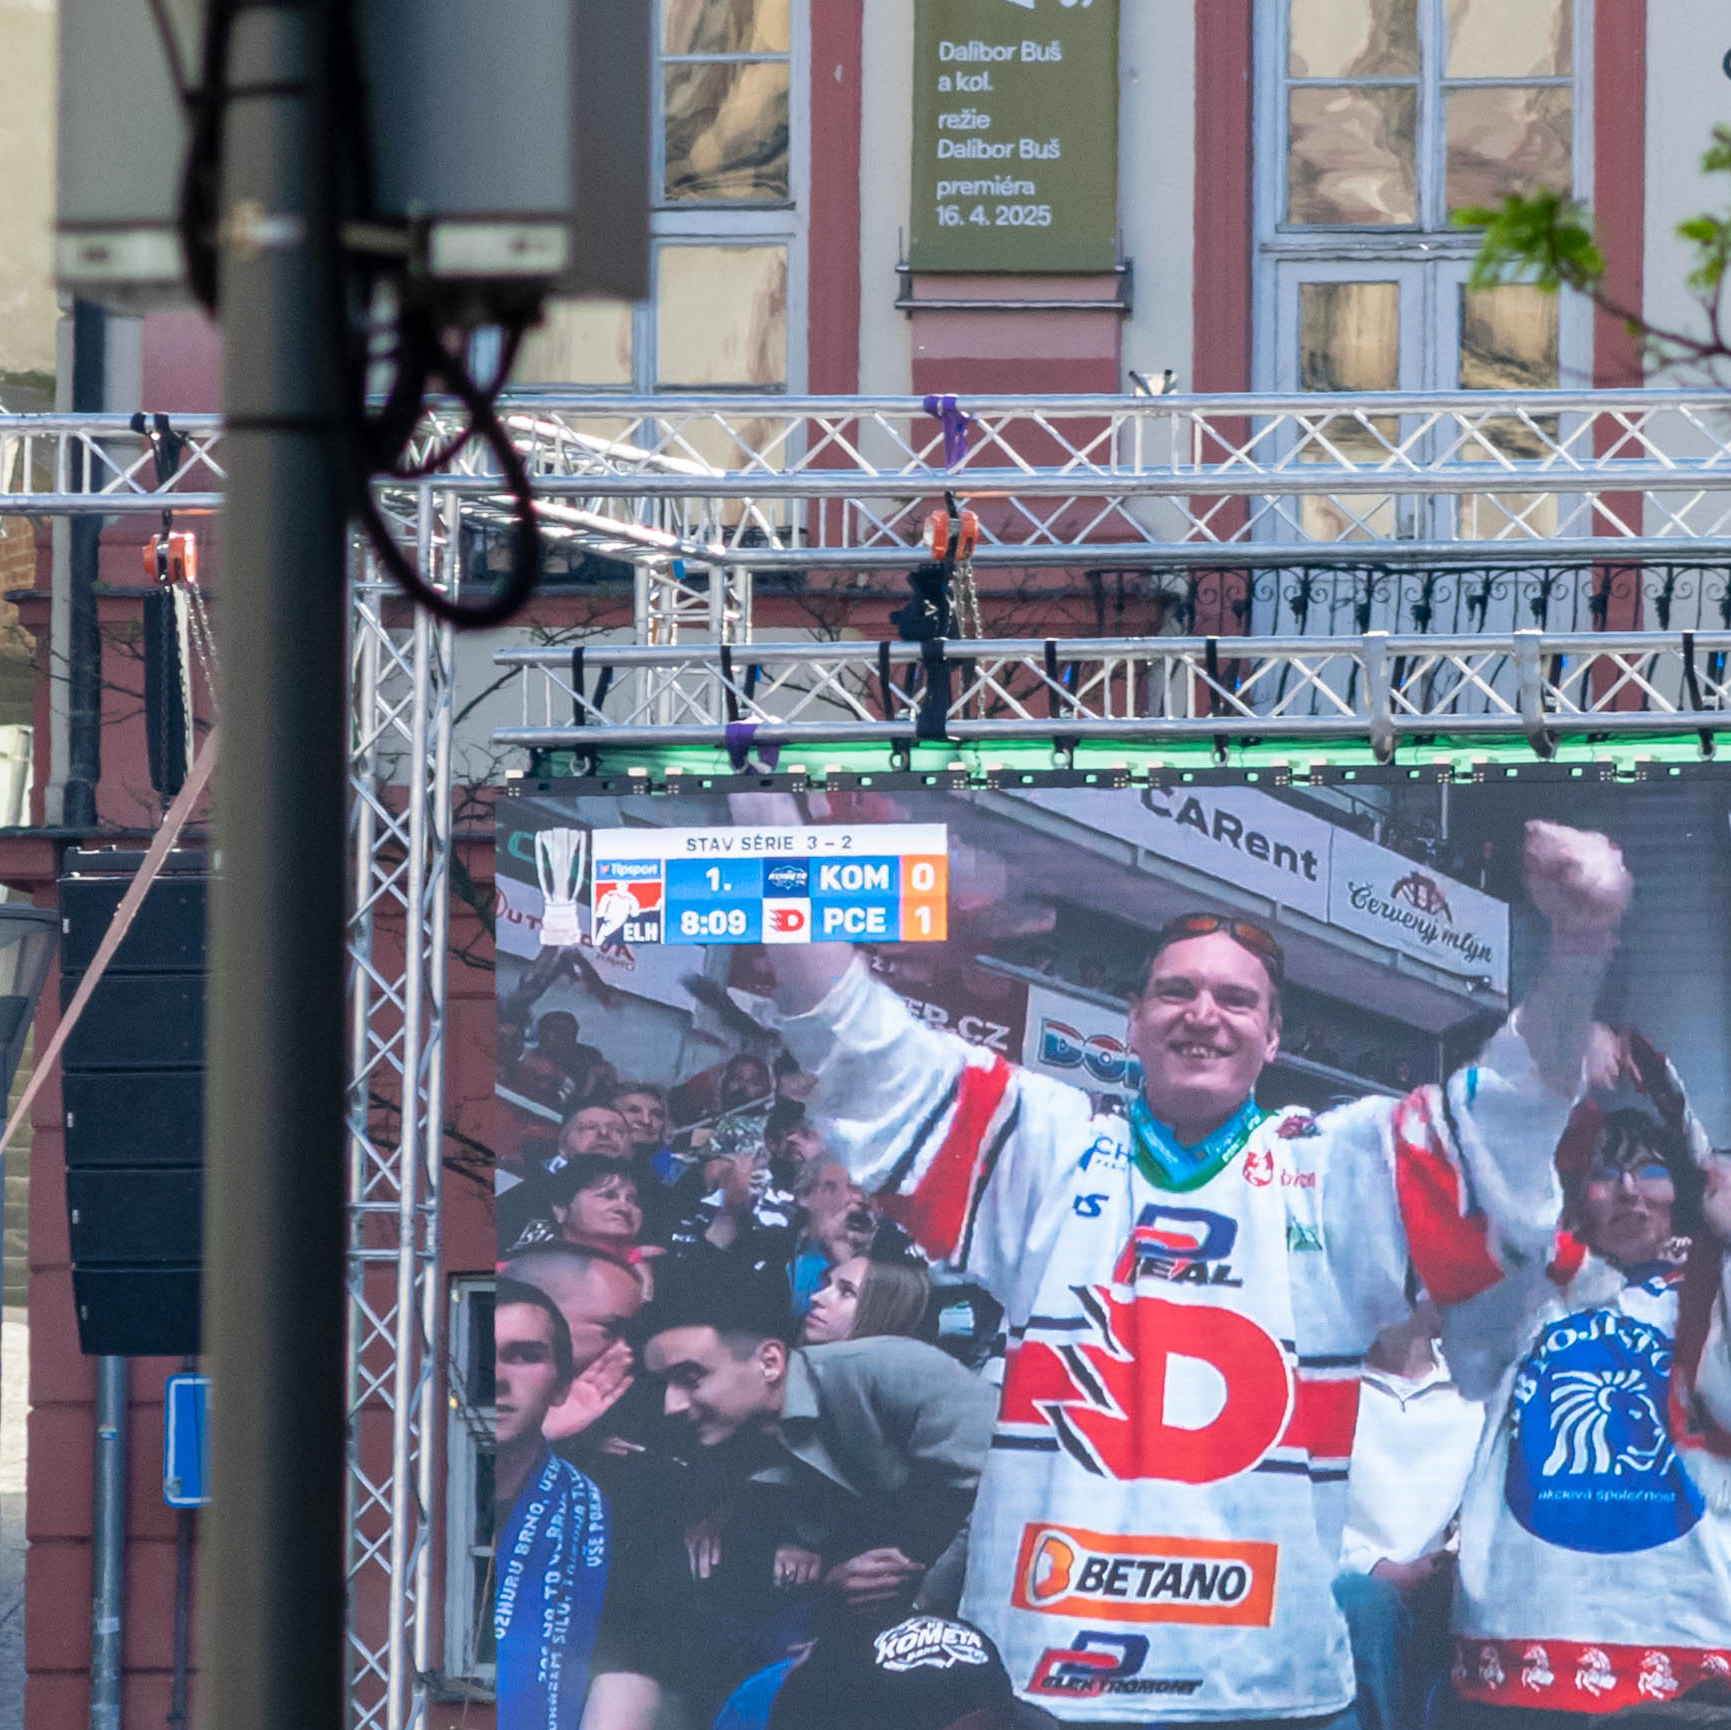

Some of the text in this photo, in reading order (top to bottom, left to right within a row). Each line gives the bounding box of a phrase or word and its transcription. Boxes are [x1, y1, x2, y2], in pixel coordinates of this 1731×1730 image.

[938, 39, 1063, 63] Dalibor Buš
[937, 70, 993, 92] a kol.
[937, 107, 991, 130] režie
[936, 137, 1061, 160] Dalibor Buš
[936, 174, 1036, 201] premiéra
[935, 203, 1053, 227] 16. 4. 2025
[686, 836, 734, 853] STAV
[740, 833, 794, 852] SÉRIE
[806, 835, 819, 851] 3
[842, 835, 854, 850] 2
[1139, 788, 1319, 883] CARent
[611, 862, 659, 878] Tipsport
[705, 867, 733, 892] 1.
[819, 863, 890, 891] KOM
[910, 863, 936, 890] 0
[623, 921, 659, 943] ELH
[680, 909, 748, 936] 8:09
[823, 906, 932, 934] PCE 1
[1075, 1556, 1249, 1603] BETANO
